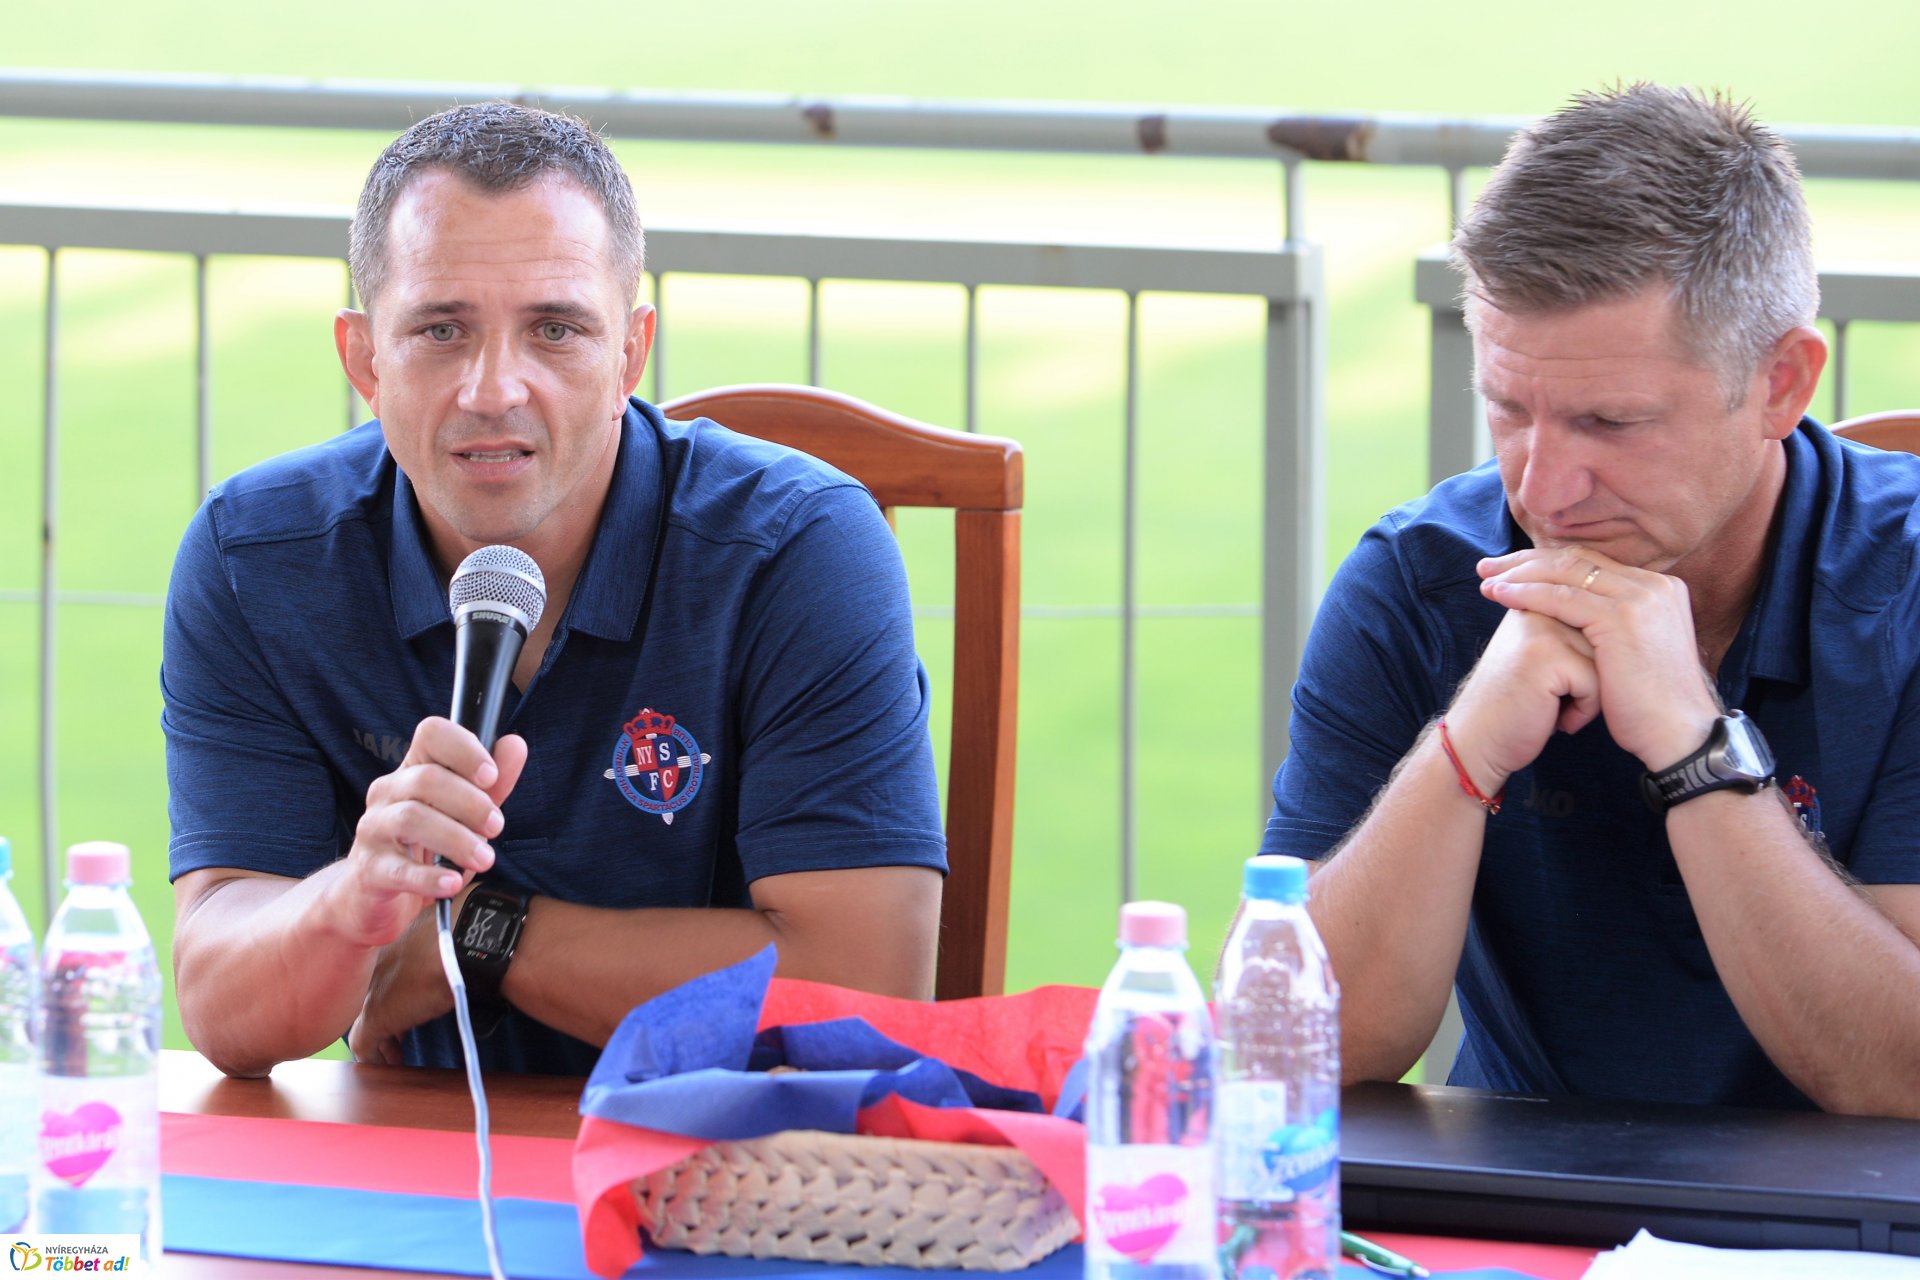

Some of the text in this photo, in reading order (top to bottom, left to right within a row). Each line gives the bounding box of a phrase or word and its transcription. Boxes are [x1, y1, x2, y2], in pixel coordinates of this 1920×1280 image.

[471, 611, 510, 625] SHURE
[636, 742, 671, 765] NY S
[649, 769, 674, 791] F C
